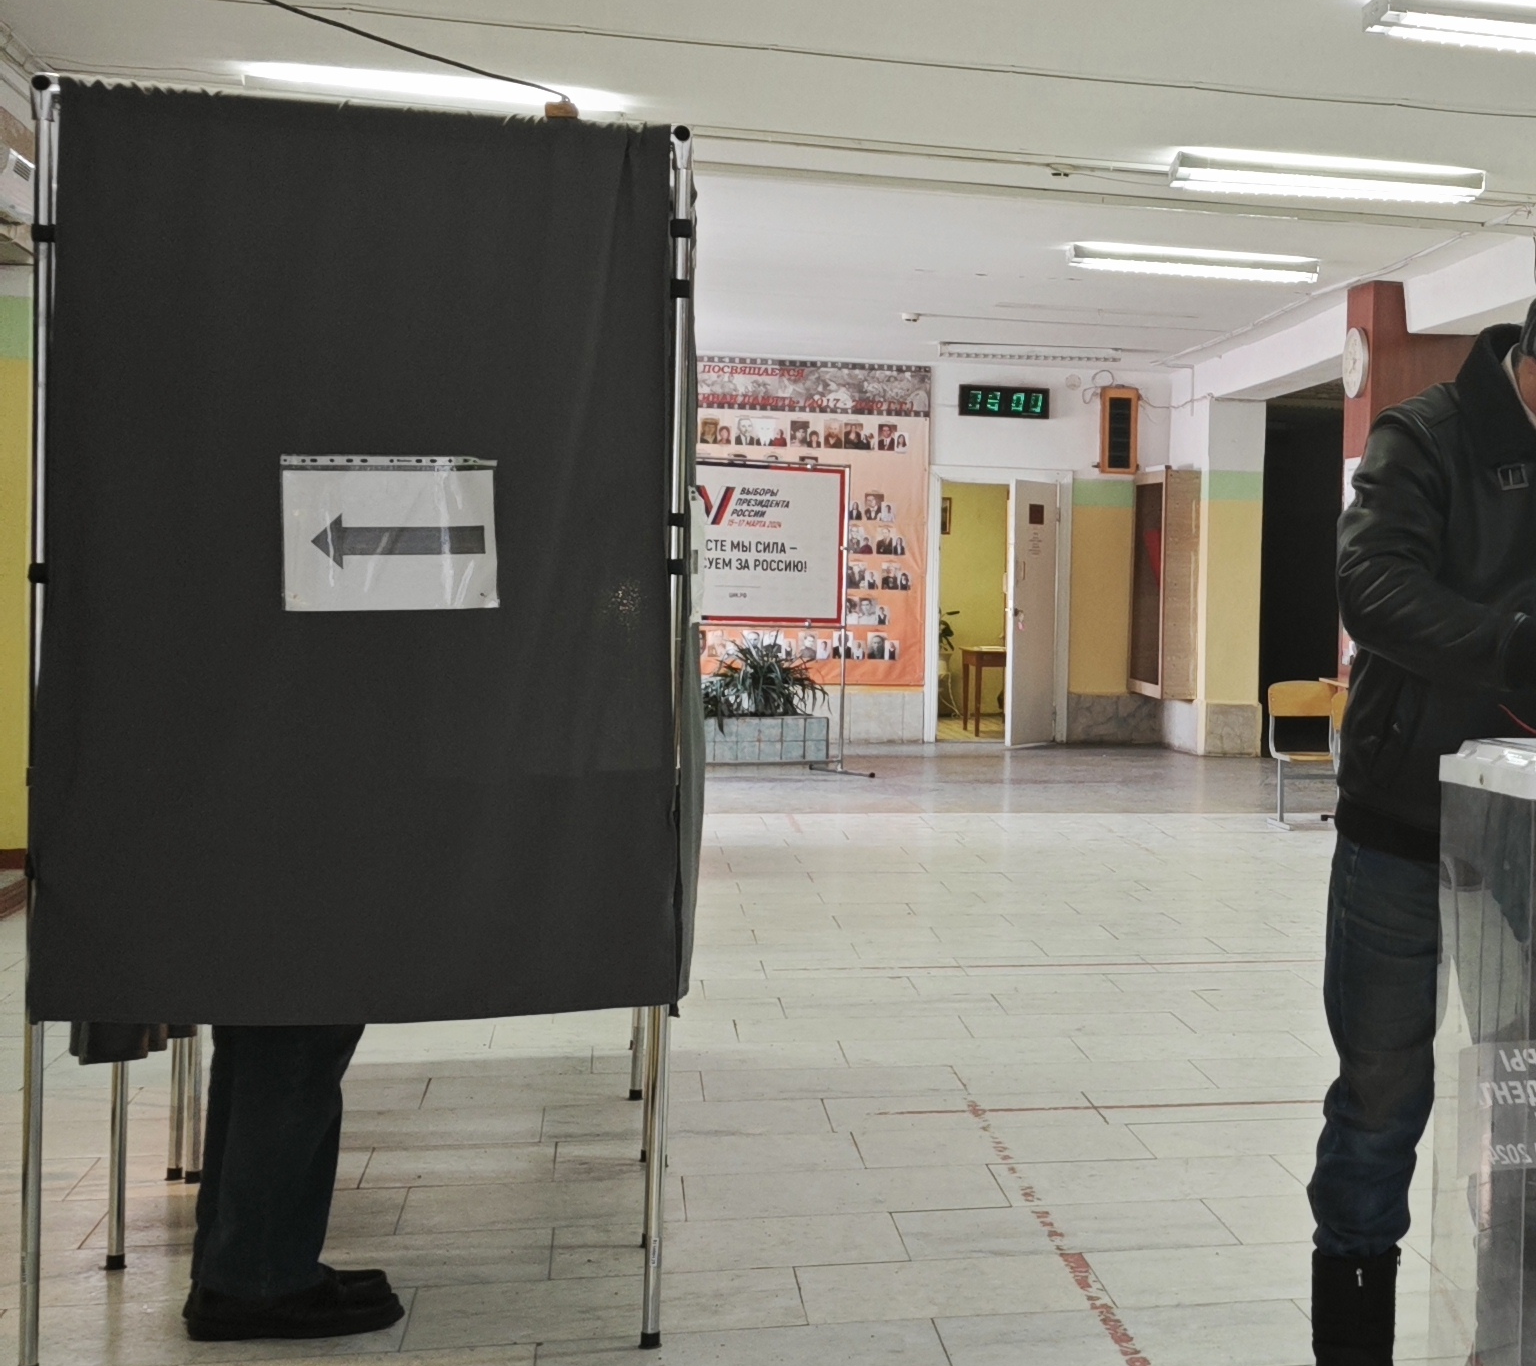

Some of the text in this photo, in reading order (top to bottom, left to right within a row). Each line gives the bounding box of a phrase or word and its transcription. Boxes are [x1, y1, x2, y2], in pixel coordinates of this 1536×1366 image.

[702, 364, 806, 378] ПОСВЯЩАЕТСЯ
[740, 487, 779, 497] ВЫБОРЫ
[735, 498, 790, 509] ПРЕЗИДЕНТА
[731, 509, 766, 518] РОССИИ
[705, 539, 727, 552] СТЕ
[730, 540, 751, 553] МЫ
[755, 541, 787, 554] СИЛА
[735, 558, 750, 571] ЗА
[753, 559, 807, 573] РОССИЮ!
